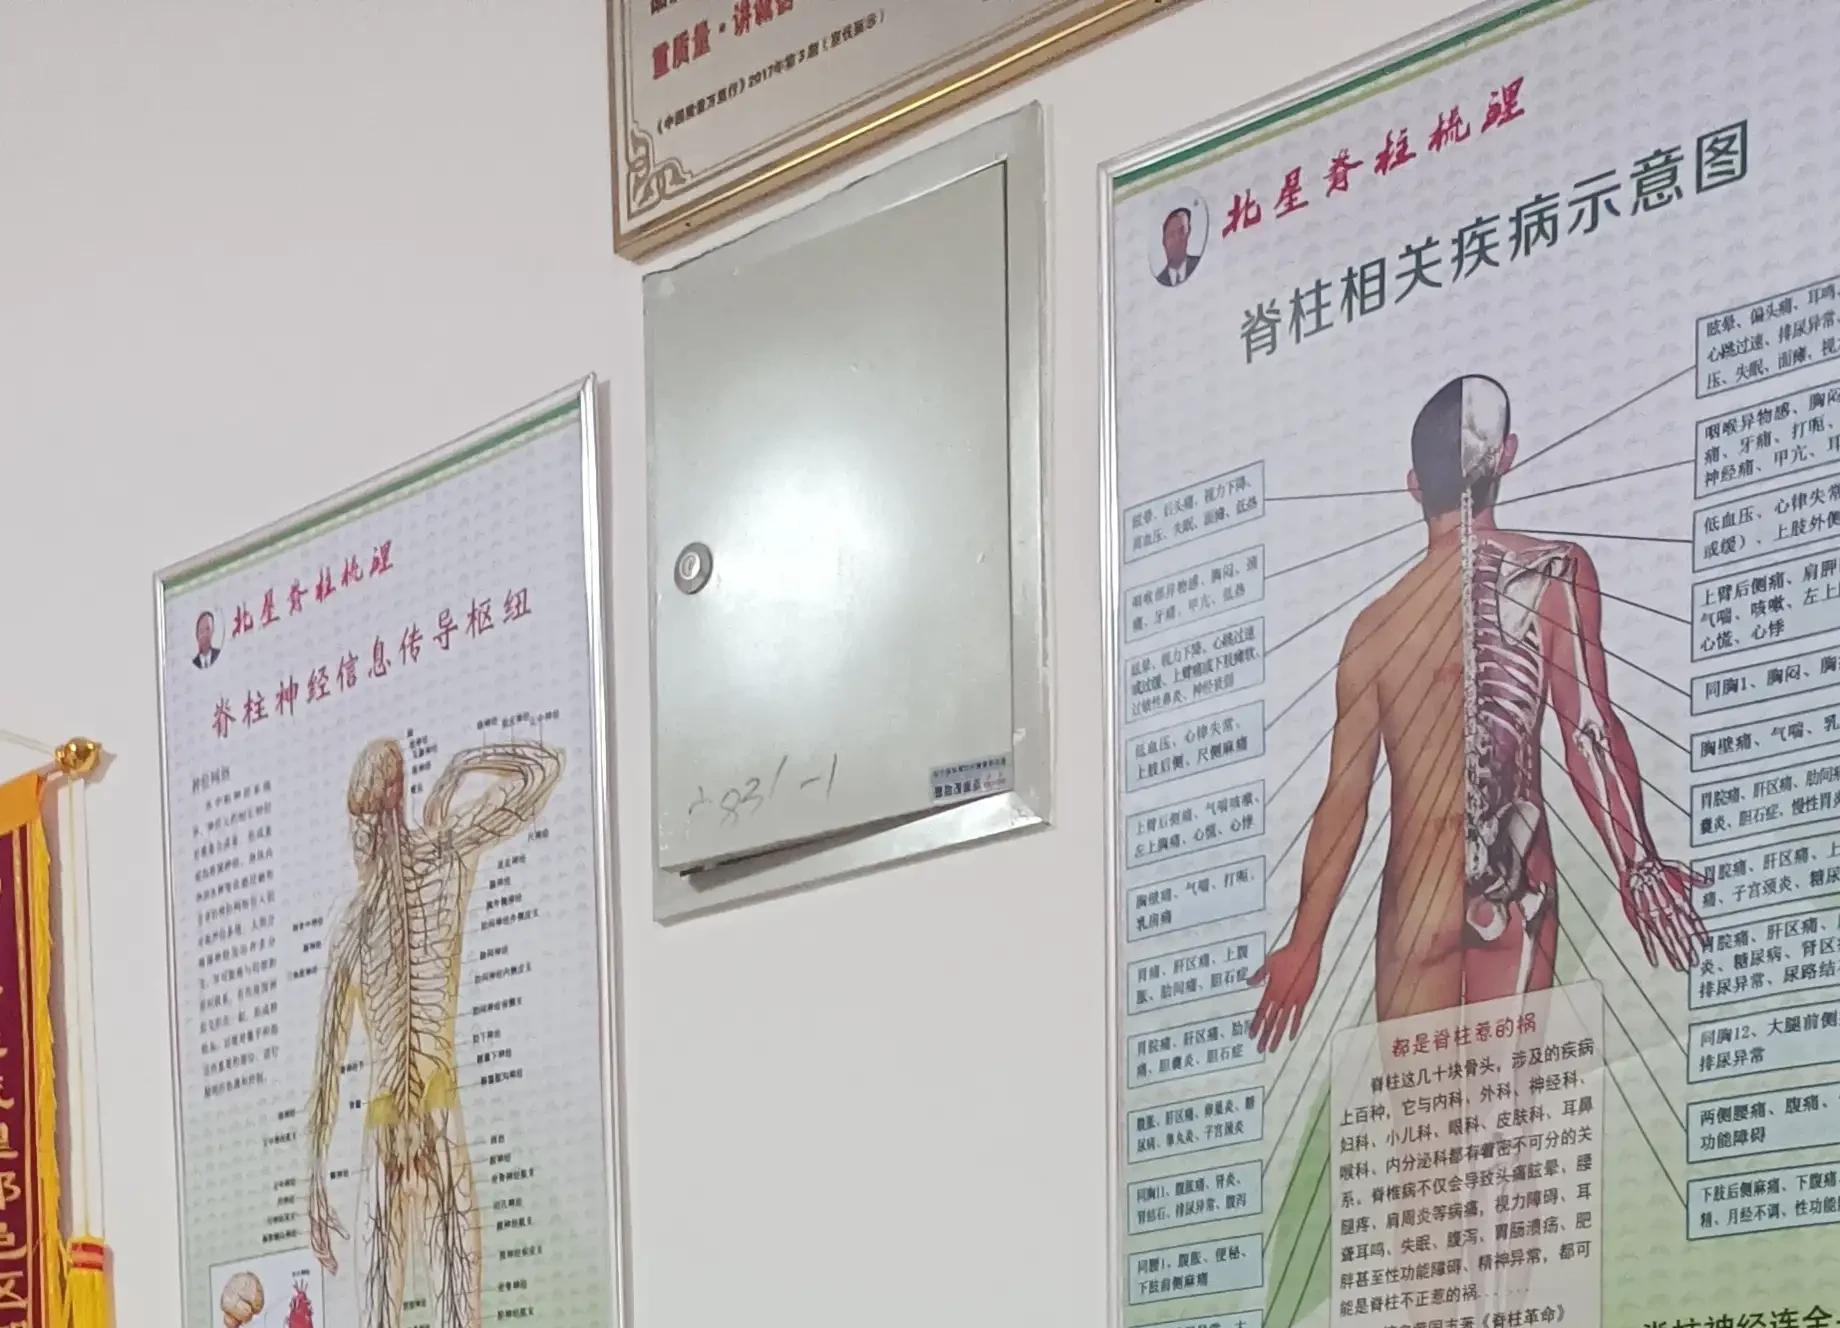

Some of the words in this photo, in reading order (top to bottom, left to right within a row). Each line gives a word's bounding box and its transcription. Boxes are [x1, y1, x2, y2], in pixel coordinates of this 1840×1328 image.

[1221, 76, 1527, 239] 北星脊柱梳理
[1240, 119, 1749, 364] 脊柱相关疾病示意图
[231, 539, 394, 638] 北星脊柱梳理
[1701, 557, 1840, 607] 上臂后侧痛、肩胛
[1700, 587, 1840, 628] 气喘、咳嗽、左上
[212, 587, 532, 739] 脊柱神经信息传导枢纽
[1705, 654, 1840, 700] 同胸1、胸闷、胸
[1700, 958, 1840, 999] 排尿异常、尿路结
[1391, 1012, 1537, 1059] 都是脊柱惹的祸
[1700, 1009, 1840, 1047] 同胸12、大腿前侧
[1700, 1047, 1765, 1072] 排尿异常
[1701, 1126, 1766, 1151] 功能障碍
[1700, 1195, 1840, 1228] 精、月经不调、性功能
